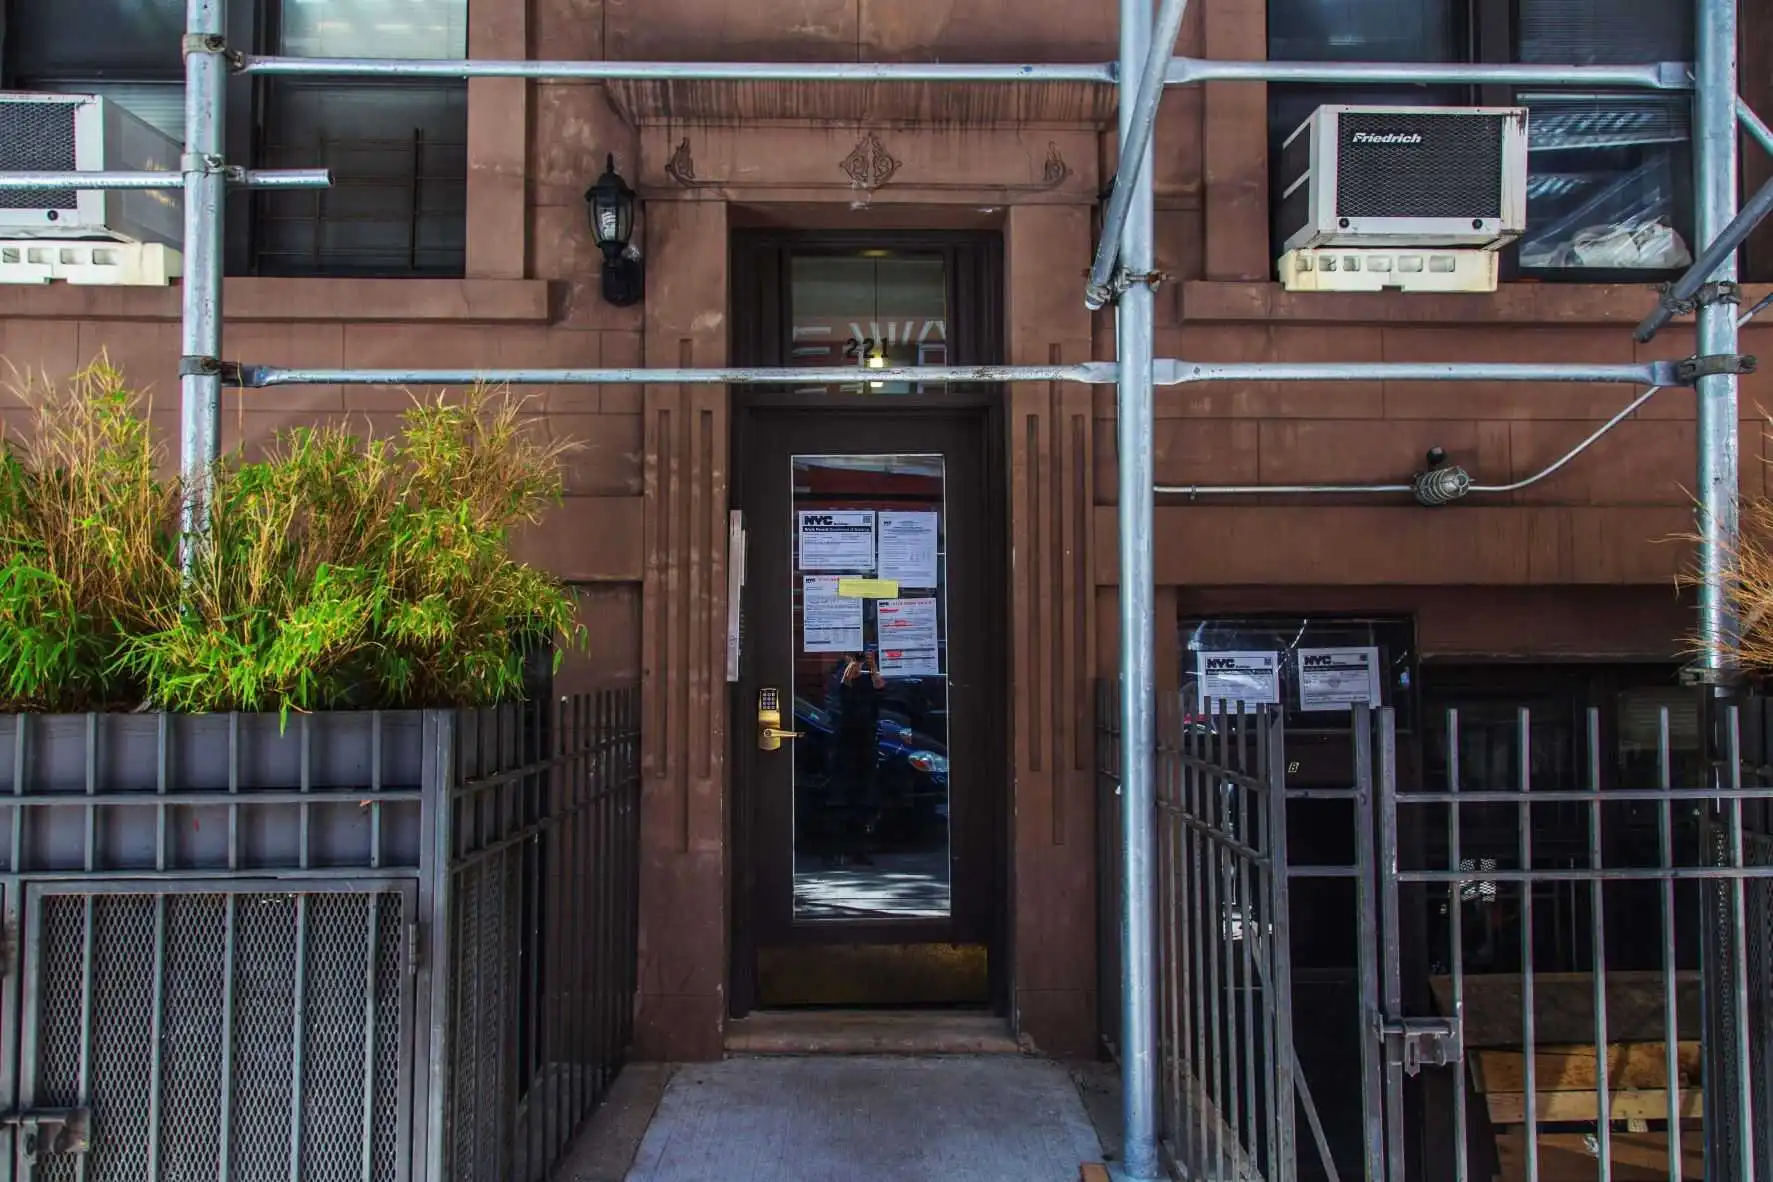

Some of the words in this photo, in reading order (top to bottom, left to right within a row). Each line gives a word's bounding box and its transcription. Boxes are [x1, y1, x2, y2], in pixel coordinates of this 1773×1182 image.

[1352, 132, 1422, 144] Friedrich
[846, 337, 889, 359] 221
[804, 515, 833, 526] NYC
[1207, 658, 1235, 668] NYC
[1304, 655, 1332, 665] NYC
